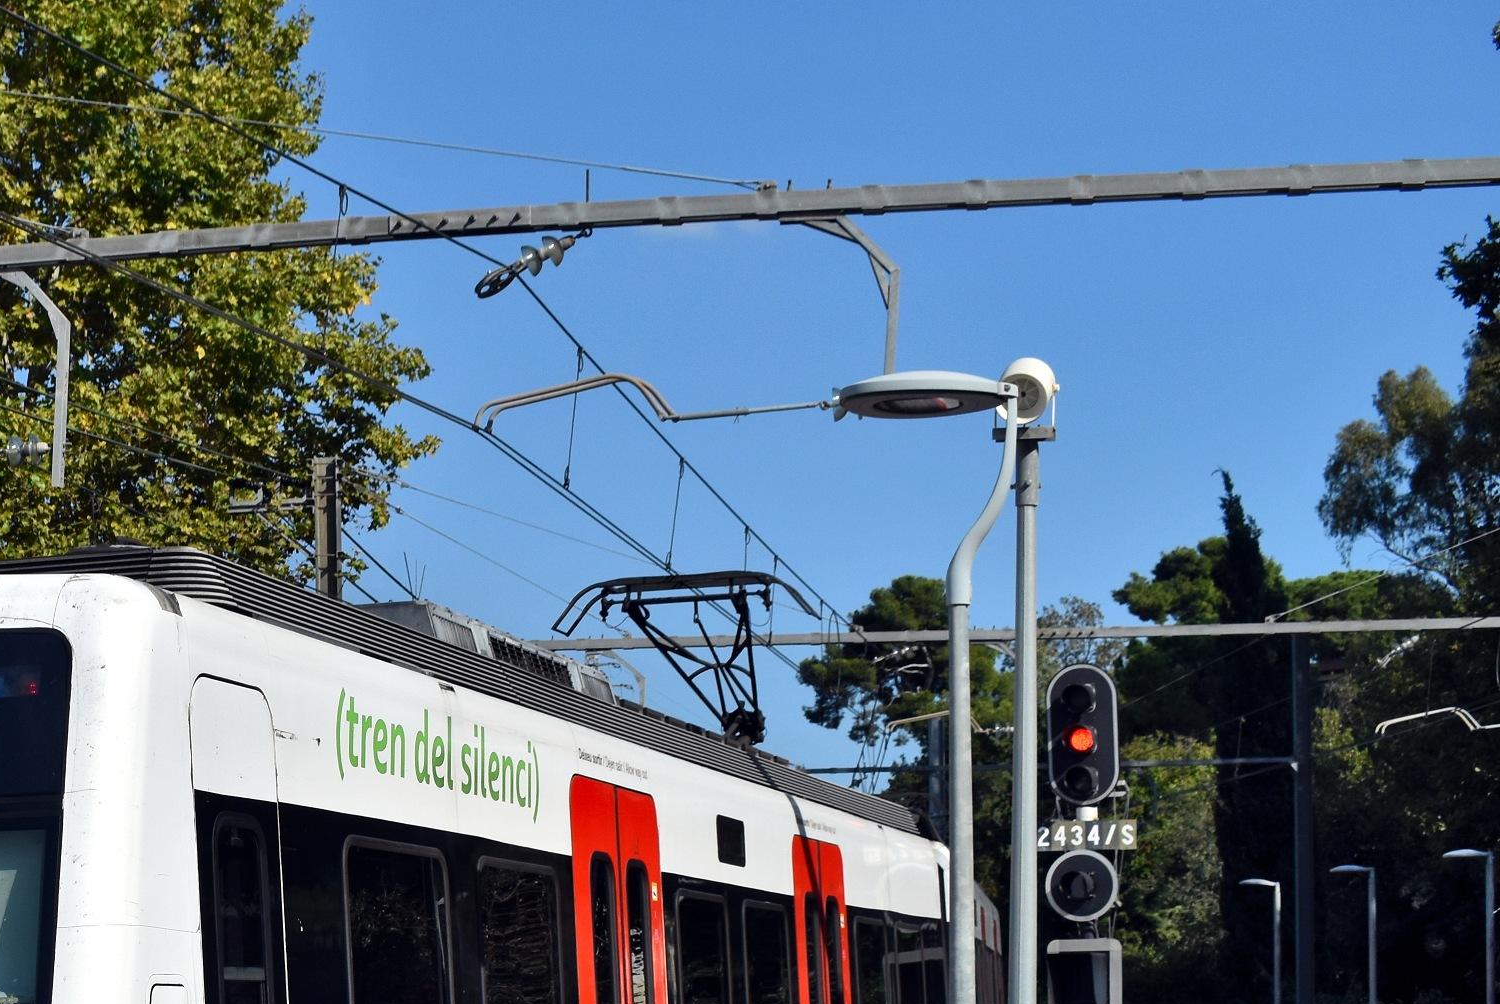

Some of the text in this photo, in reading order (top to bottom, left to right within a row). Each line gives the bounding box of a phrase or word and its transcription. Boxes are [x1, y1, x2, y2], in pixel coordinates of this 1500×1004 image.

[336, 687, 540, 825] (tren del silenci)
[1037, 823, 1134, 847] 2434/S
